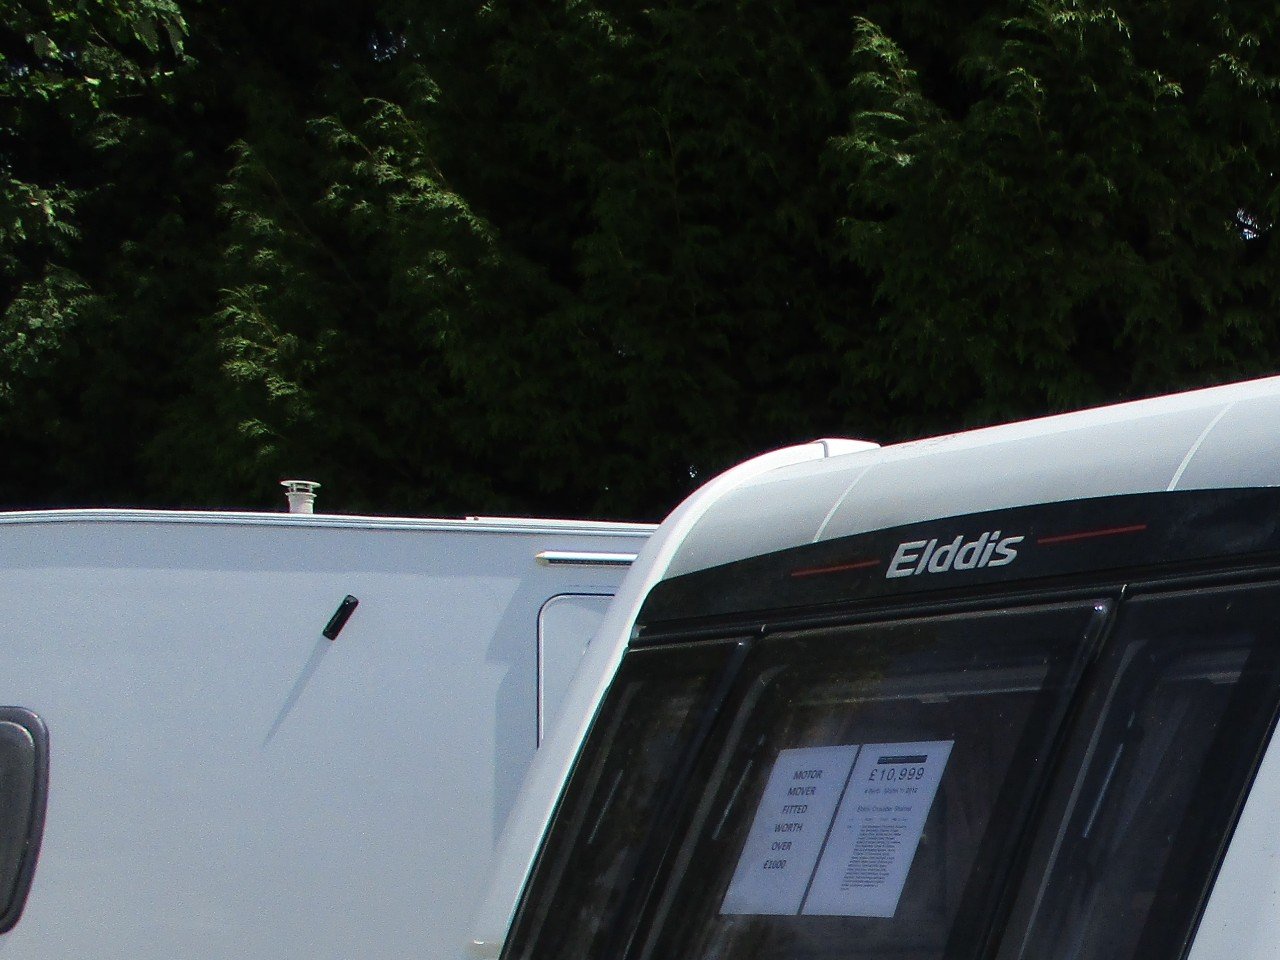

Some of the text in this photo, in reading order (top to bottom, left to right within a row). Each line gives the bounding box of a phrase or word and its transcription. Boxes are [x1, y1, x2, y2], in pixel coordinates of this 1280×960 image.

[886, 531, 1024, 578] Elddis
[793, 769, 822, 780] MOTOR
[869, 767, 925, 782] £10,999
[787, 786, 816, 796] MOVER
[782, 804, 807, 814] FITTED
[774, 823, 803, 833] WORTH
[771, 841, 792, 851] OVER
